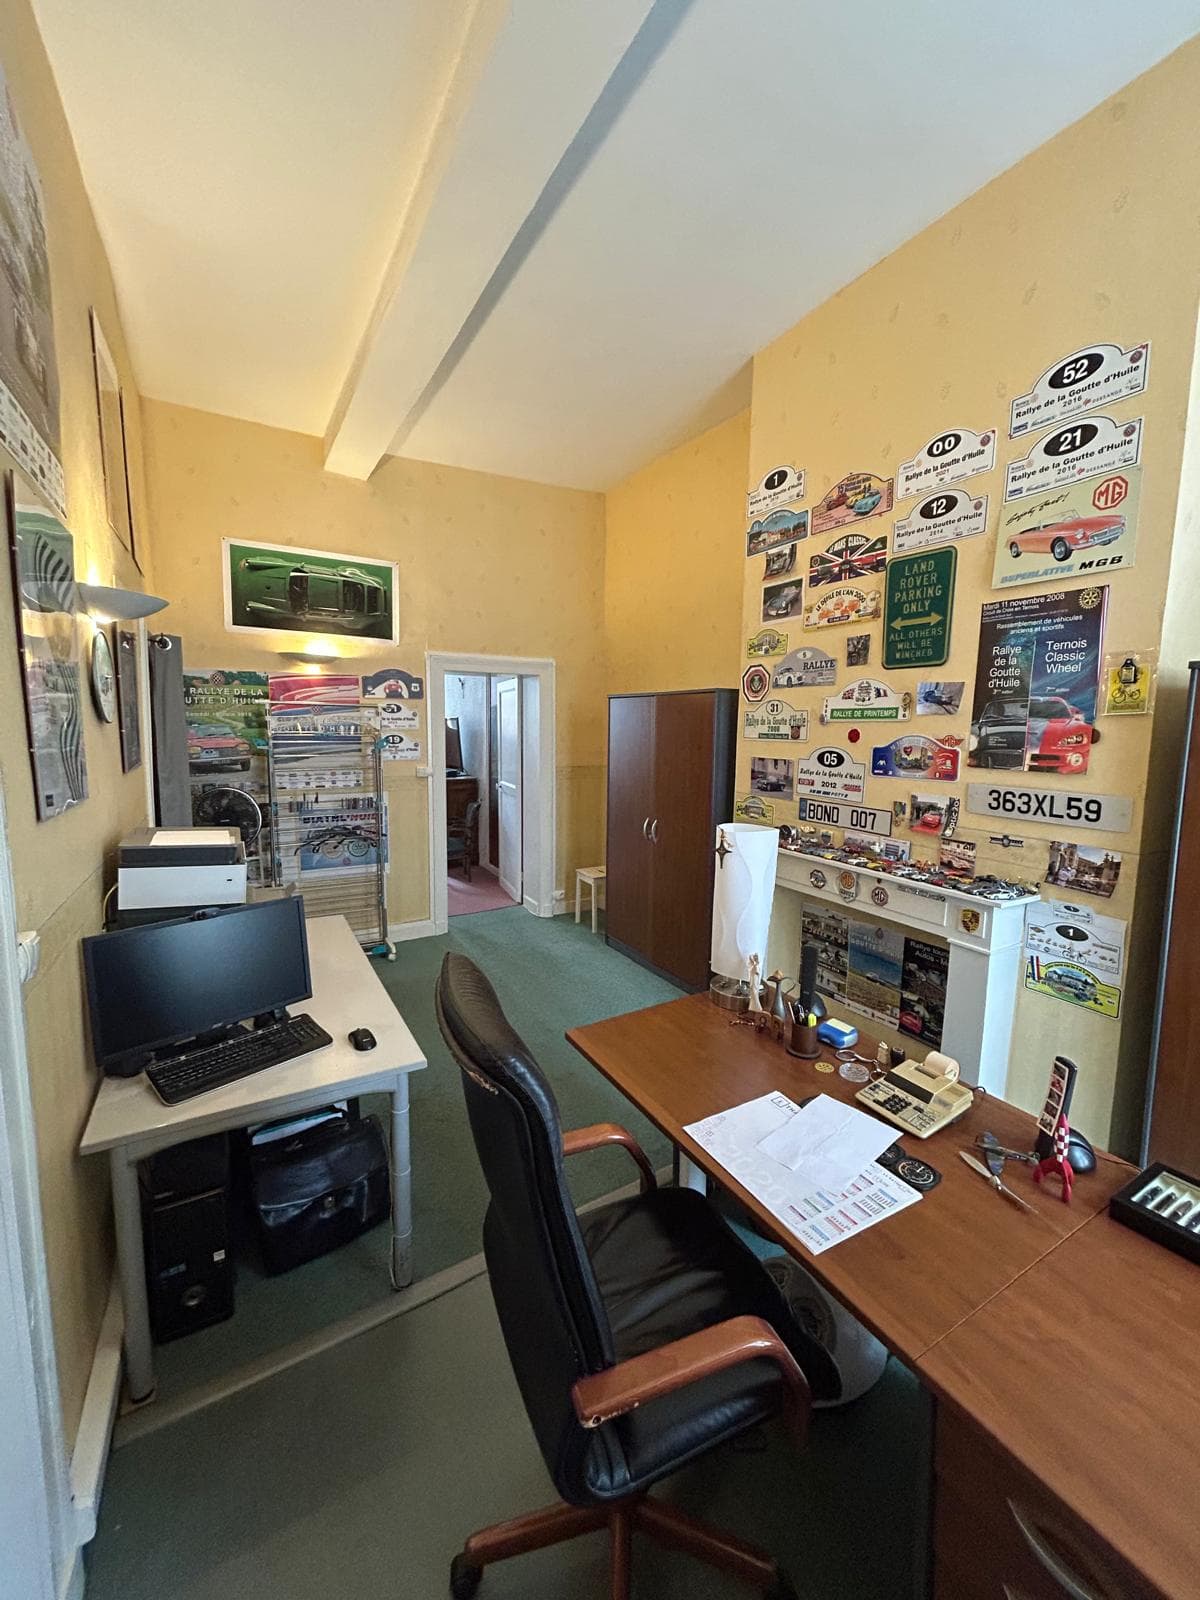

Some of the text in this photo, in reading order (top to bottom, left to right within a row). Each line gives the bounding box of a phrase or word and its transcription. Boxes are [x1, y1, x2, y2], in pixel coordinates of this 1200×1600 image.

[1062, 358, 1089, 385] 52
[1015, 403, 1042, 419] Rallye
[1044, 398, 1055, 408] de
[1057, 393, 1066, 403] la
[1068, 379, 1101, 398] Goutte
[1104, 364, 1140, 384] d'Huile
[932, 436, 956, 455] 00
[1058, 428, 1082, 452] 21
[905, 472, 923, 483] Rallye
[932, 464, 939, 473] la
[940, 458, 961, 468] Goutte
[962, 448, 986, 462] d'Huile
[1011, 469, 1037, 483] Rallye
[1039, 464, 1051, 474] de
[1052, 460, 1061, 470] la
[1063, 450, 1095, 465] Goutte
[1098, 438, 1133, 454] d'Huile
[1057, 463, 1077, 475] 2016
[773, 473, 779, 487] 1
[1097, 481, 1123, 506] MG
[931, 498, 947, 516] 12
[896, 530, 915, 539] Rallye
[932, 519, 956, 529] Goutte
[957, 511, 983, 523] d'Huile
[905, 560, 935, 576] LAND
[1079, 555, 1123, 571] MGB
[900, 573, 938, 589] ROVER
[894, 584, 943, 603] PARKING
[903, 600, 931, 614] ONLY
[983, 602, 1000, 611] Mardi
[1009, 596, 1045, 608] novembre
[1046, 592, 1065, 602] 2008
[996, 619, 1042, 629] Rassemblement
[1009, 627, 1034, 635] anciens
[1042, 623, 1065, 632] sportifs
[889, 627, 943, 642] ALL OTHERS
[897, 639, 932, 650] WILL BE
[1045, 637, 1088, 651] Ternois
[992, 645, 1022, 660] Rallye
[1045, 650, 1086, 663] Classic
[802, 660, 836, 671] RALLYE
[994, 656, 1017, 666] de la
[1046, 662, 1082, 674] Wheel
[989, 667, 1021, 678] Goutte
[988, 678, 1021, 688] d'Huile
[189, 687, 264, 696] RALLYE DE LA
[185, 696, 215, 704] UTTE
[770, 703, 779, 713] 31
[832, 710, 853, 718] RALLYE
[853, 710, 863, 718] DE
[863, 709, 897, 718] PRINTEMPS
[823, 752, 838, 766] 05
[799, 767, 815, 777] Rallye
[828, 770, 844, 779] Goutte
[821, 780, 837, 789] 2012
[987, 788, 1103, 823] 363XL59
[808, 802, 877, 830] BOND 007
[1068, 928, 1074, 937] 1
